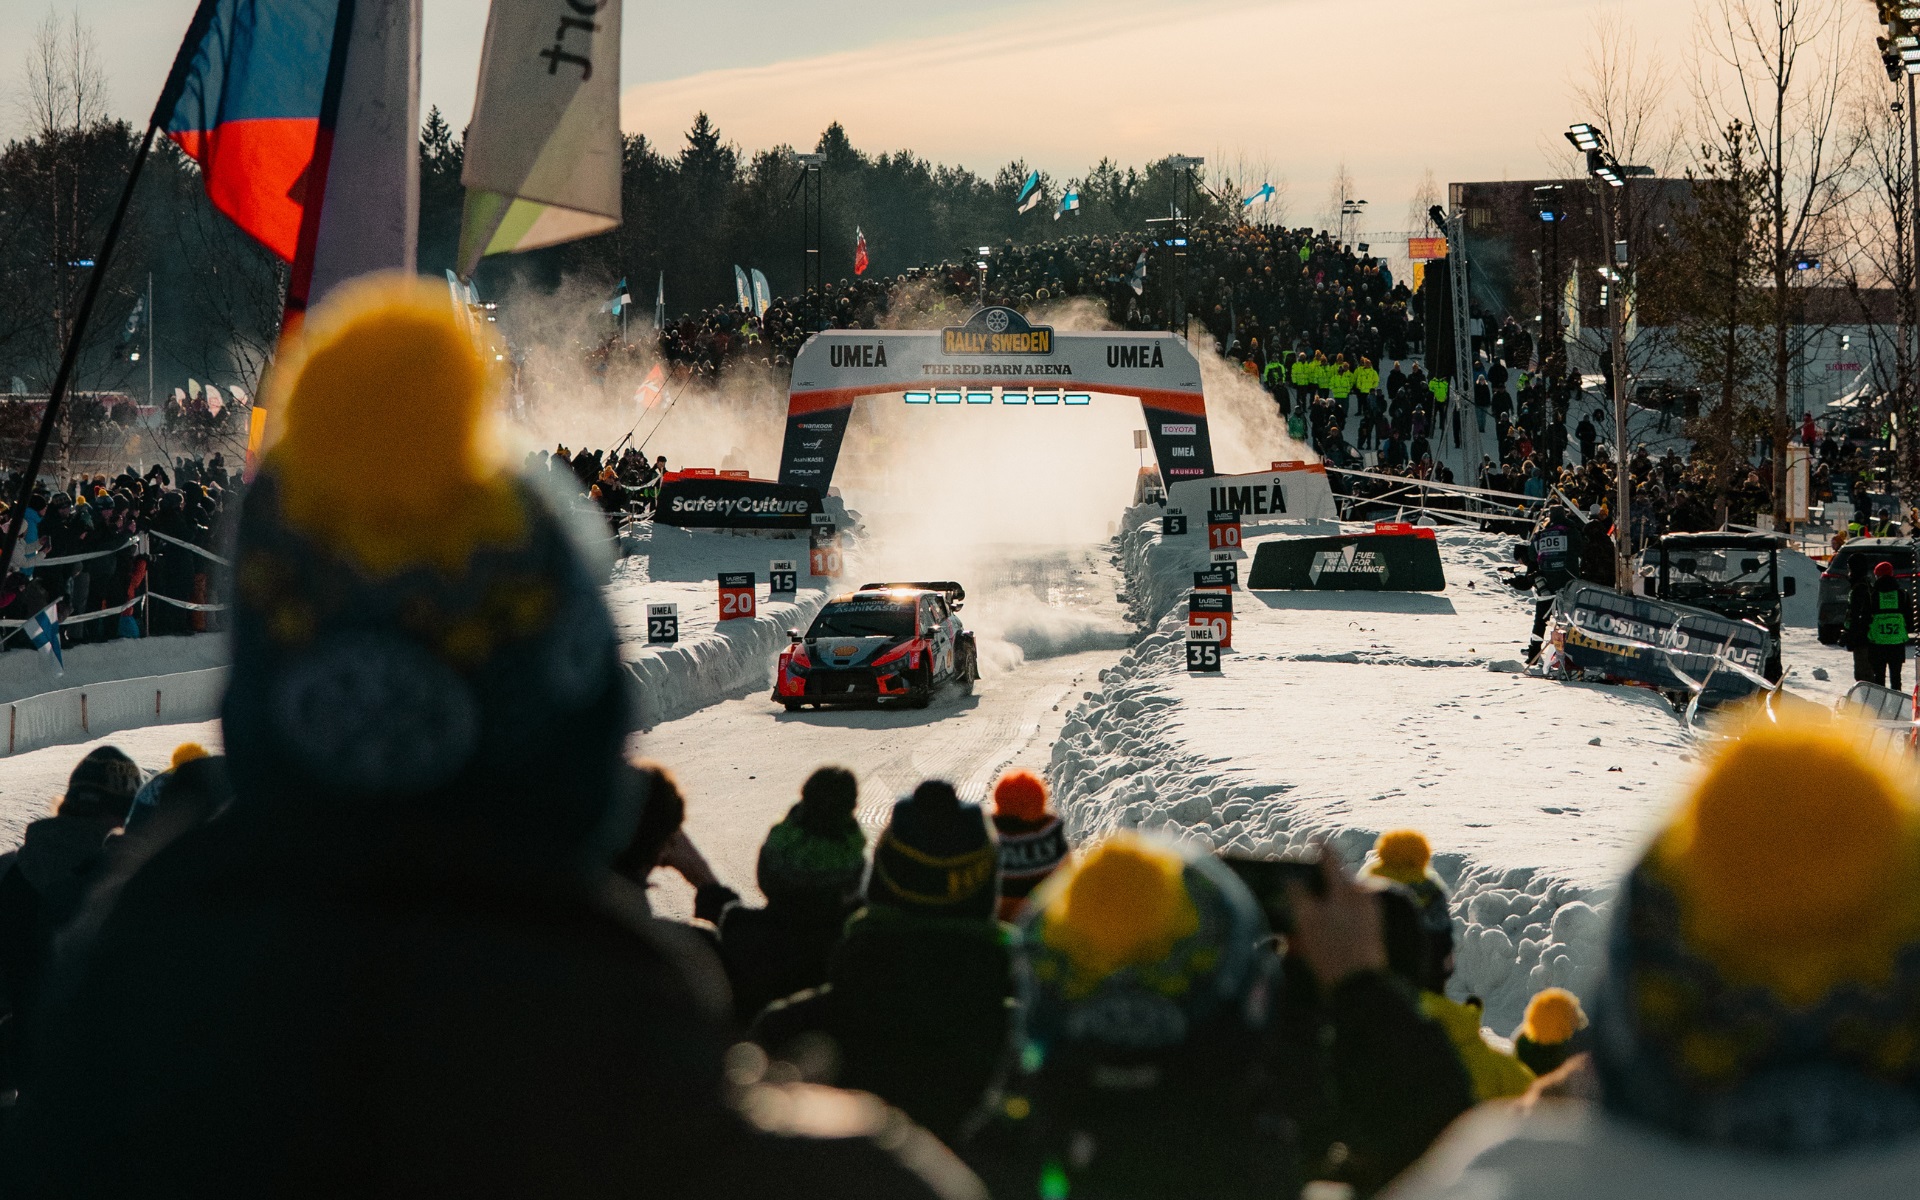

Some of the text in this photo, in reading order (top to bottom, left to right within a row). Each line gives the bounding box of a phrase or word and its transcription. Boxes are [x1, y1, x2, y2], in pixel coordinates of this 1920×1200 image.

[945, 330, 1049, 352] RALLY SWEDEN
[829, 340, 888, 368] UMEÅ
[1106, 340, 1164, 368] UMEÅ
[922, 364, 1073, 375] THE RED BARN ARENA
[1171, 445, 1195, 457] UMEÅ
[1210, 477, 1287, 515] UMEÅ
[671, 495, 809, 517] SafetyCulture
[1166, 506, 1183, 515] UMEÅ
[815, 514, 832, 523] UMEÅ
[1170, 518, 1180, 533] 5
[819, 526, 828, 537] 5
[1212, 527, 1239, 546] 10
[1214, 552, 1233, 561] UMEÅ
[1355, 551, 1376, 559] FUEL
[773, 561, 792, 570] UMEÅ
[813, 553, 840, 572] 10
[1349, 565, 1386, 573] CHANGE
[772, 574, 794, 590] 15
[722, 592, 752, 614] 20
[1198, 597, 1223, 605] WRC
[651, 605, 672, 615] UMEÅ
[650, 619, 676, 638] 25
[1572, 607, 1656, 643] CLOSER
[1878, 623, 1900, 635] 152
[1190, 627, 1213, 640] UMEÅ
[1190, 645, 1217, 666] 35
